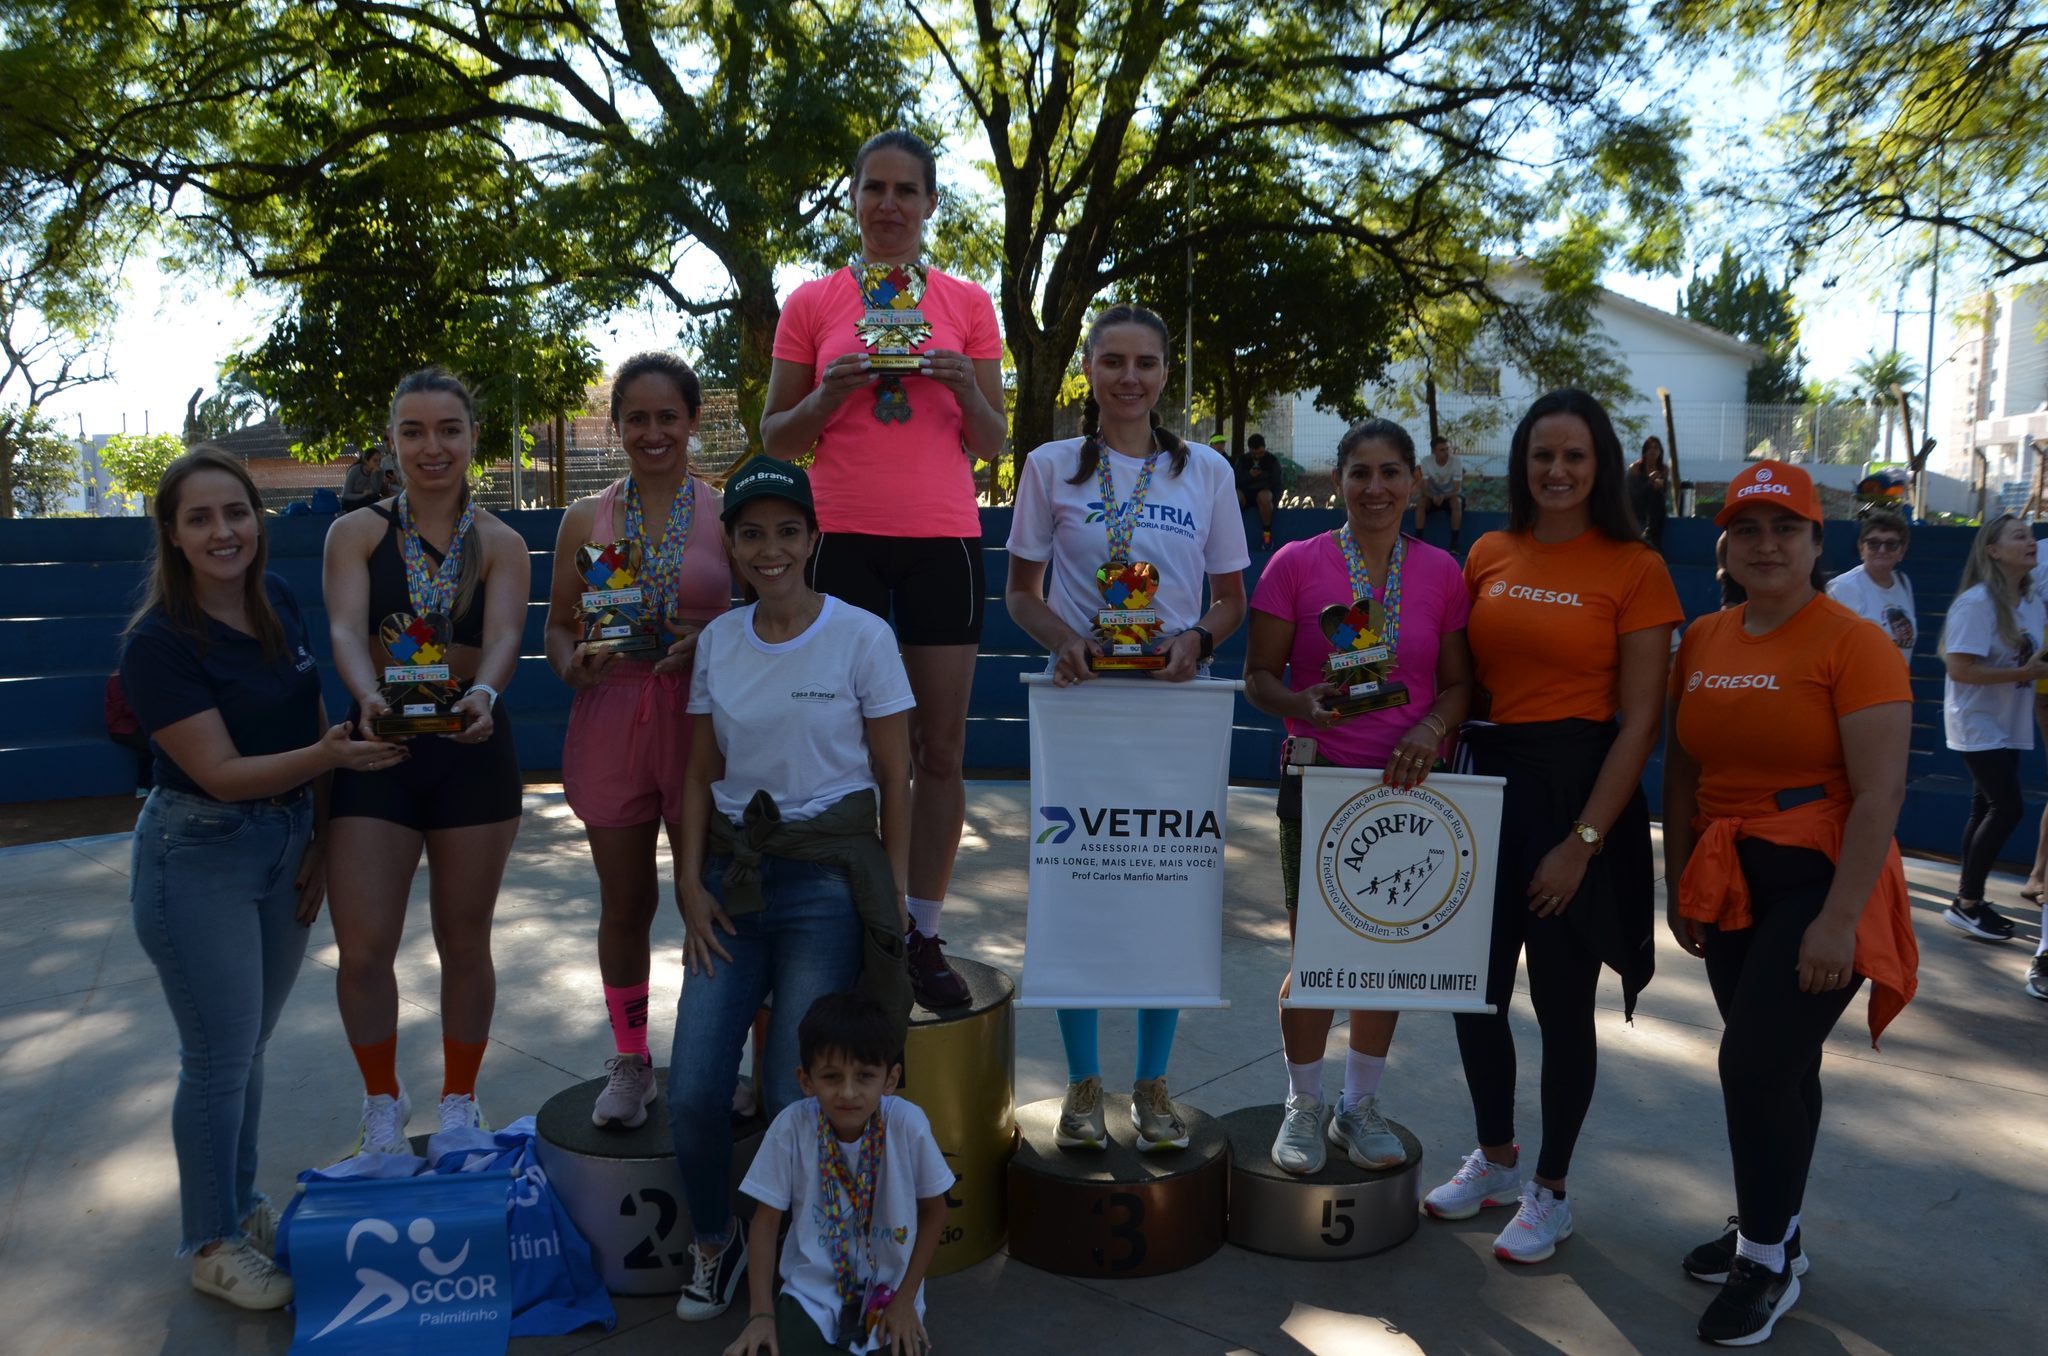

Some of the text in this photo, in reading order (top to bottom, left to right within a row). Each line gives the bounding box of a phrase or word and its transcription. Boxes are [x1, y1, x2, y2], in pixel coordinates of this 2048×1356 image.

[867, 314, 921, 324] Autismo
[735, 472, 794, 490] Casa Branca
[1737, 484, 1792, 498] CRESOL
[1114, 502, 1195, 530] VTRIA
[1160, 524, 1194, 540] ESPORTIVA
[586, 594, 640, 606] Autismo
[1508, 584, 1584, 606] CRESOL
[1102, 613, 1154, 624] Autismo
[1334, 653, 1386, 669] Autismo
[388, 670, 447, 681] Autismo
[1704, 674, 1781, 690] CRESOL
[809, 691, 835, 699] Branca
[1332, 793, 1376, 835] Associação
[1378, 788, 1390, 798] de
[1443, 807, 1454, 820] de
[1450, 819, 1464, 840] Rua
[1079, 807, 1222, 840] VETRIA
[1080, 843, 1218, 854] ASSESSORIA DE CORRIDA
[1343, 813, 1435, 873] ACORFW
[1036, 857, 1060, 865] MAIS
[1063, 858, 1098, 867] LONGE,
[1130, 859, 1156, 868] LEVE,
[1187, 858, 1216, 868] VOCÊ!
[1072, 871, 1188, 882] Prof Carlos Manfio Martins
[1324, 856, 1340, 904] Frederico
[1434, 870, 1470, 923] Desde 2024
[1300, 968, 1476, 991] VOCÊ É O SEU ÚNICO LIMITE!
[620, 1188, 682, 1270] 2
[1092, 1192, 1146, 1271] 3
[1321, 1199, 1355, 1246] 5
[412, 1274, 496, 1304] GCOR
[420, 1308, 498, 1326] Palmitinho
